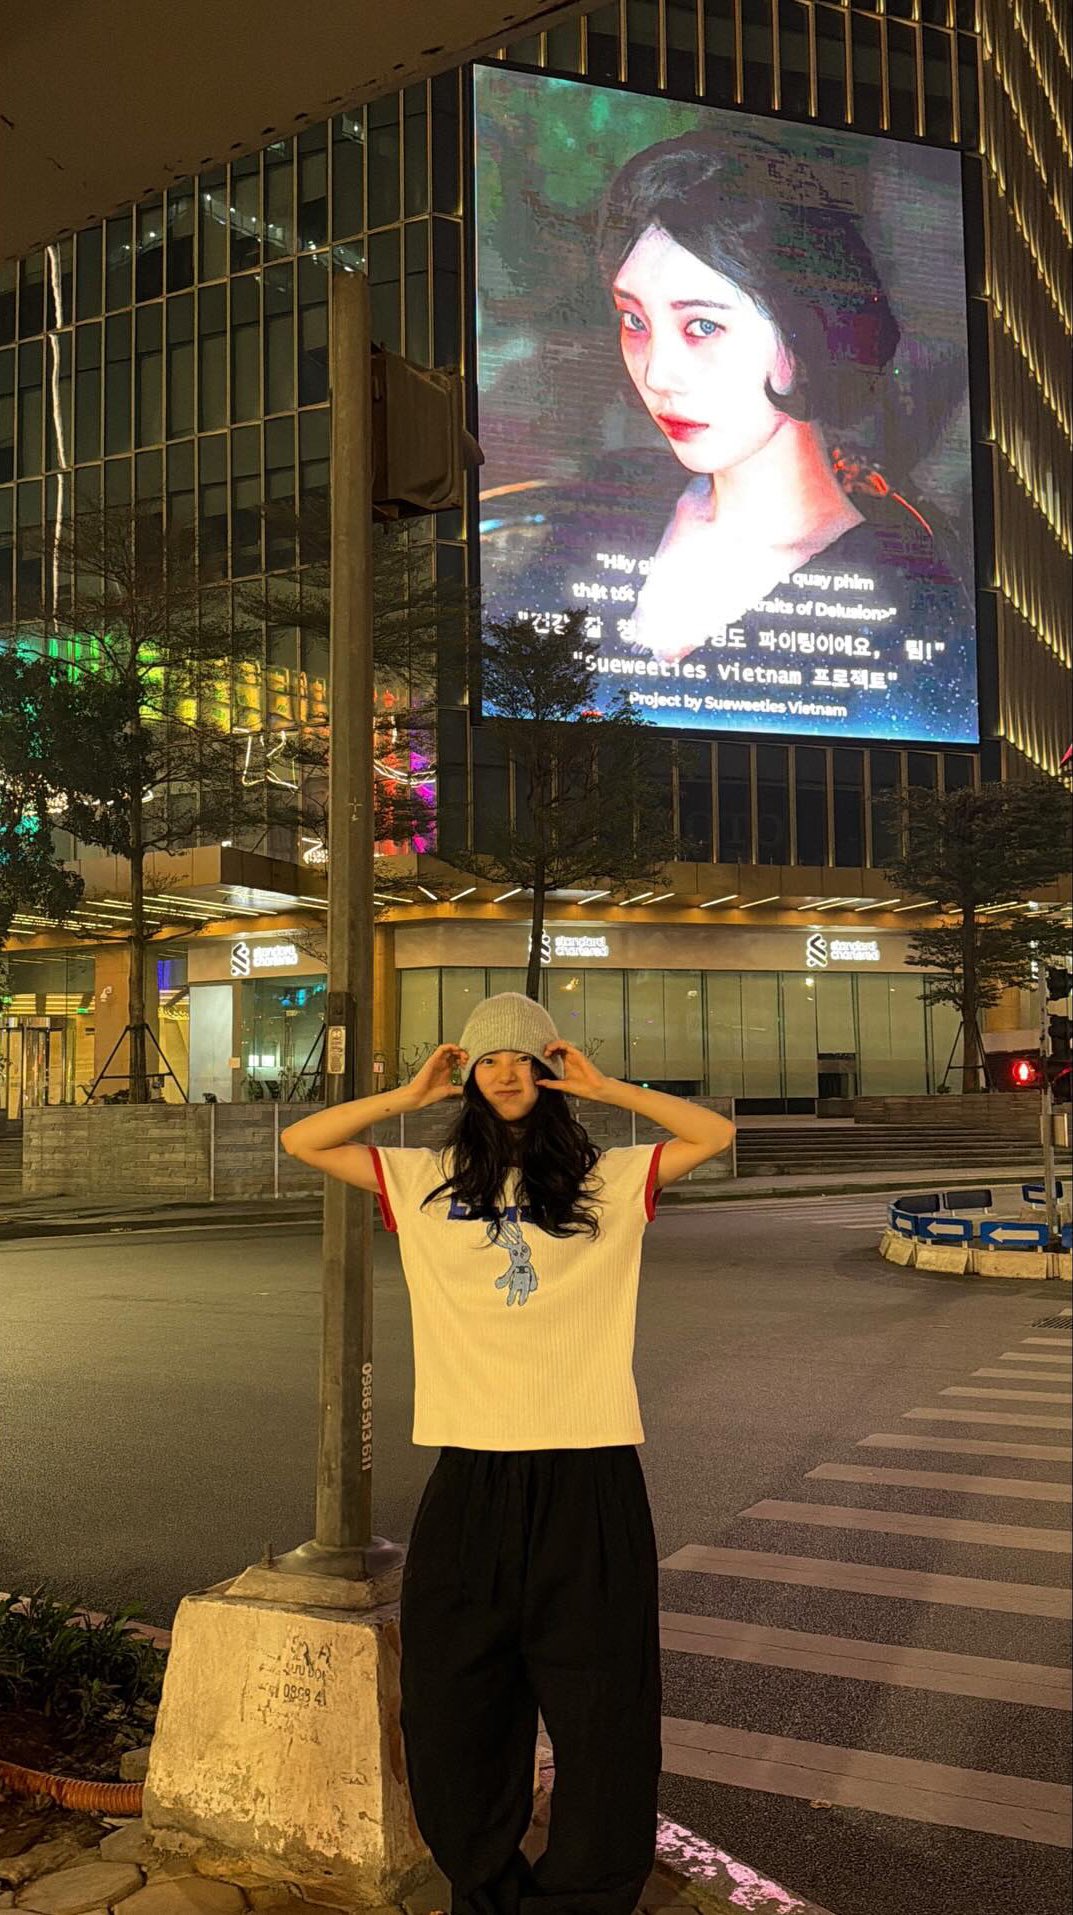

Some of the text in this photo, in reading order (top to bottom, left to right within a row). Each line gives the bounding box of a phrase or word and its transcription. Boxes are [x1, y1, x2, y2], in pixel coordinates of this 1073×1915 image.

[792, 573, 832, 590] quay
[834, 574, 875, 591] phim
[796, 600, 814, 616] of
[757, 629, 881, 660] 파이팅이에요,
[573, 651, 898, 690] "Sueweeties Vietnam 프로젝트"
[629, 691, 848, 717] Project by Sueweeties Vietnam
